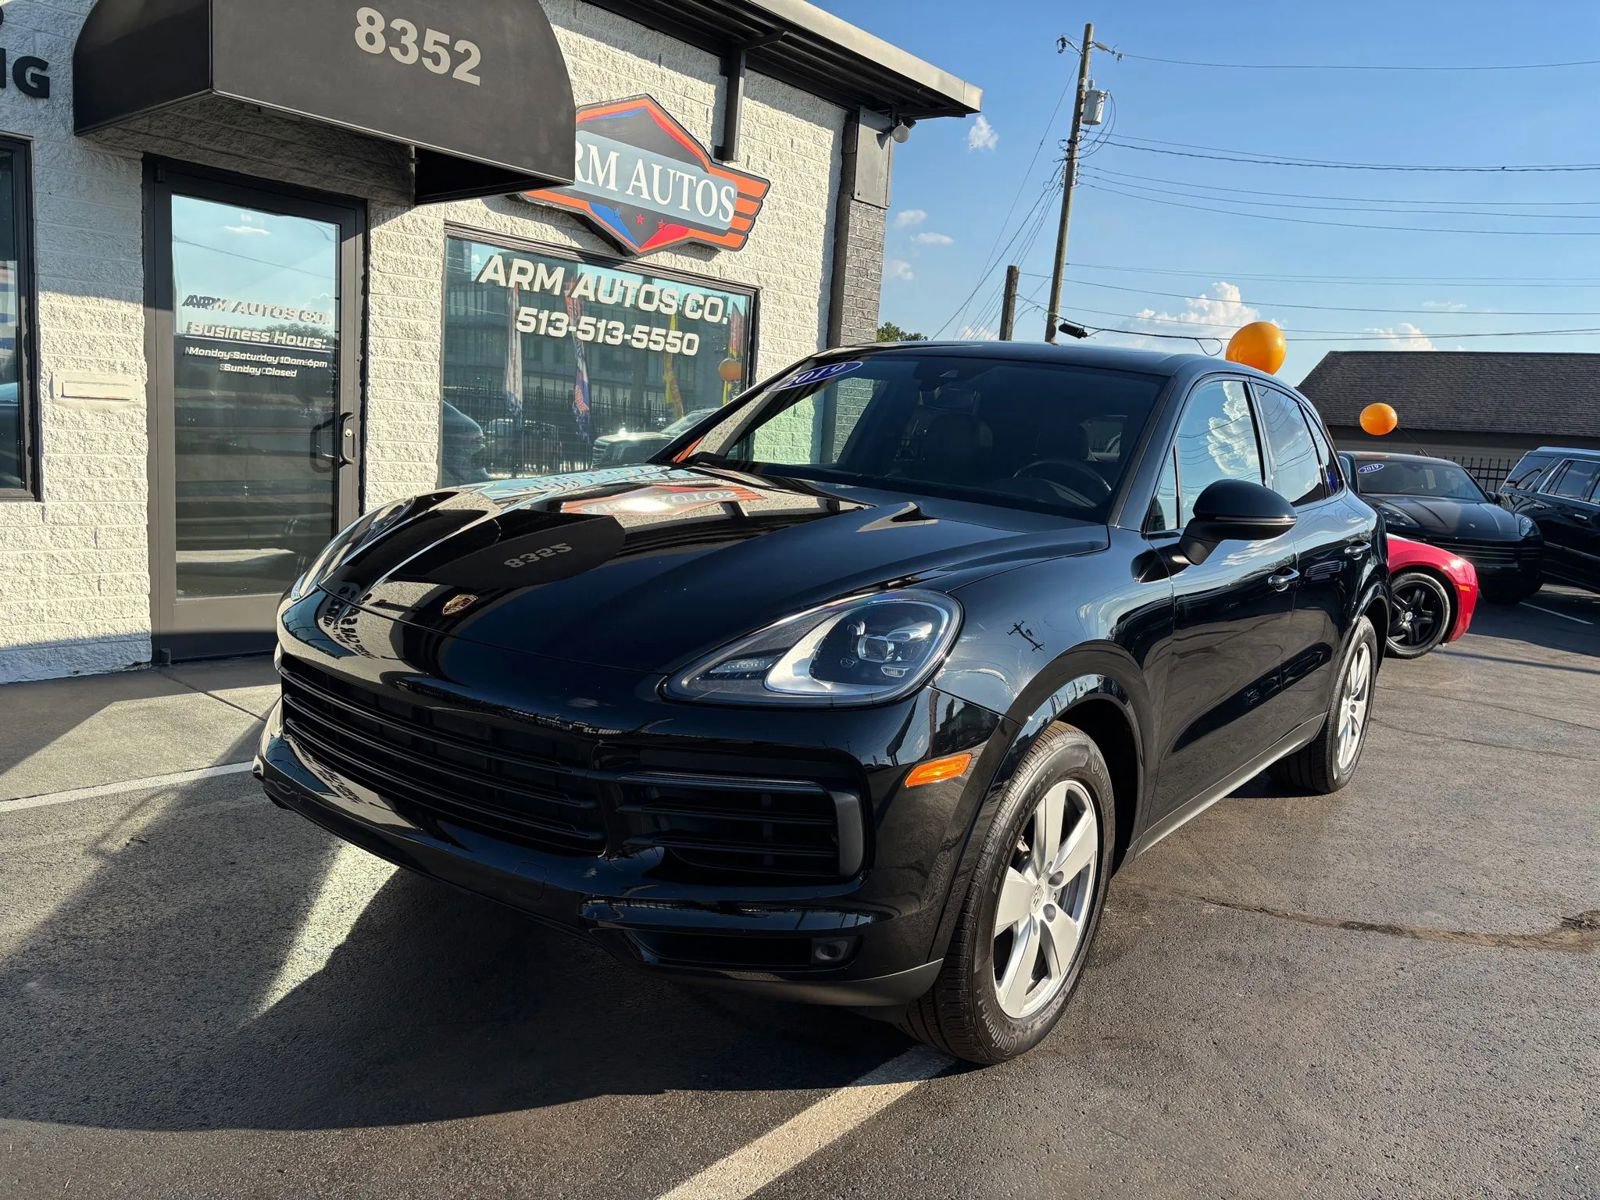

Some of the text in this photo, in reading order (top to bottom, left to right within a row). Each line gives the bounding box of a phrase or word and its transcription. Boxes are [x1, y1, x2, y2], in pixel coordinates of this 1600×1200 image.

[355, 6, 481, 86] 8352
[625, 159, 736, 224] AUTOS
[232, 301, 295, 320] AUTOS
[478, 254, 728, 325] ARM AUTOS CO.
[190, 320, 327, 349] Business Hours:
[516, 306, 700, 356] 513-513-5550
[223, 363, 298, 378] Sunday Closed
